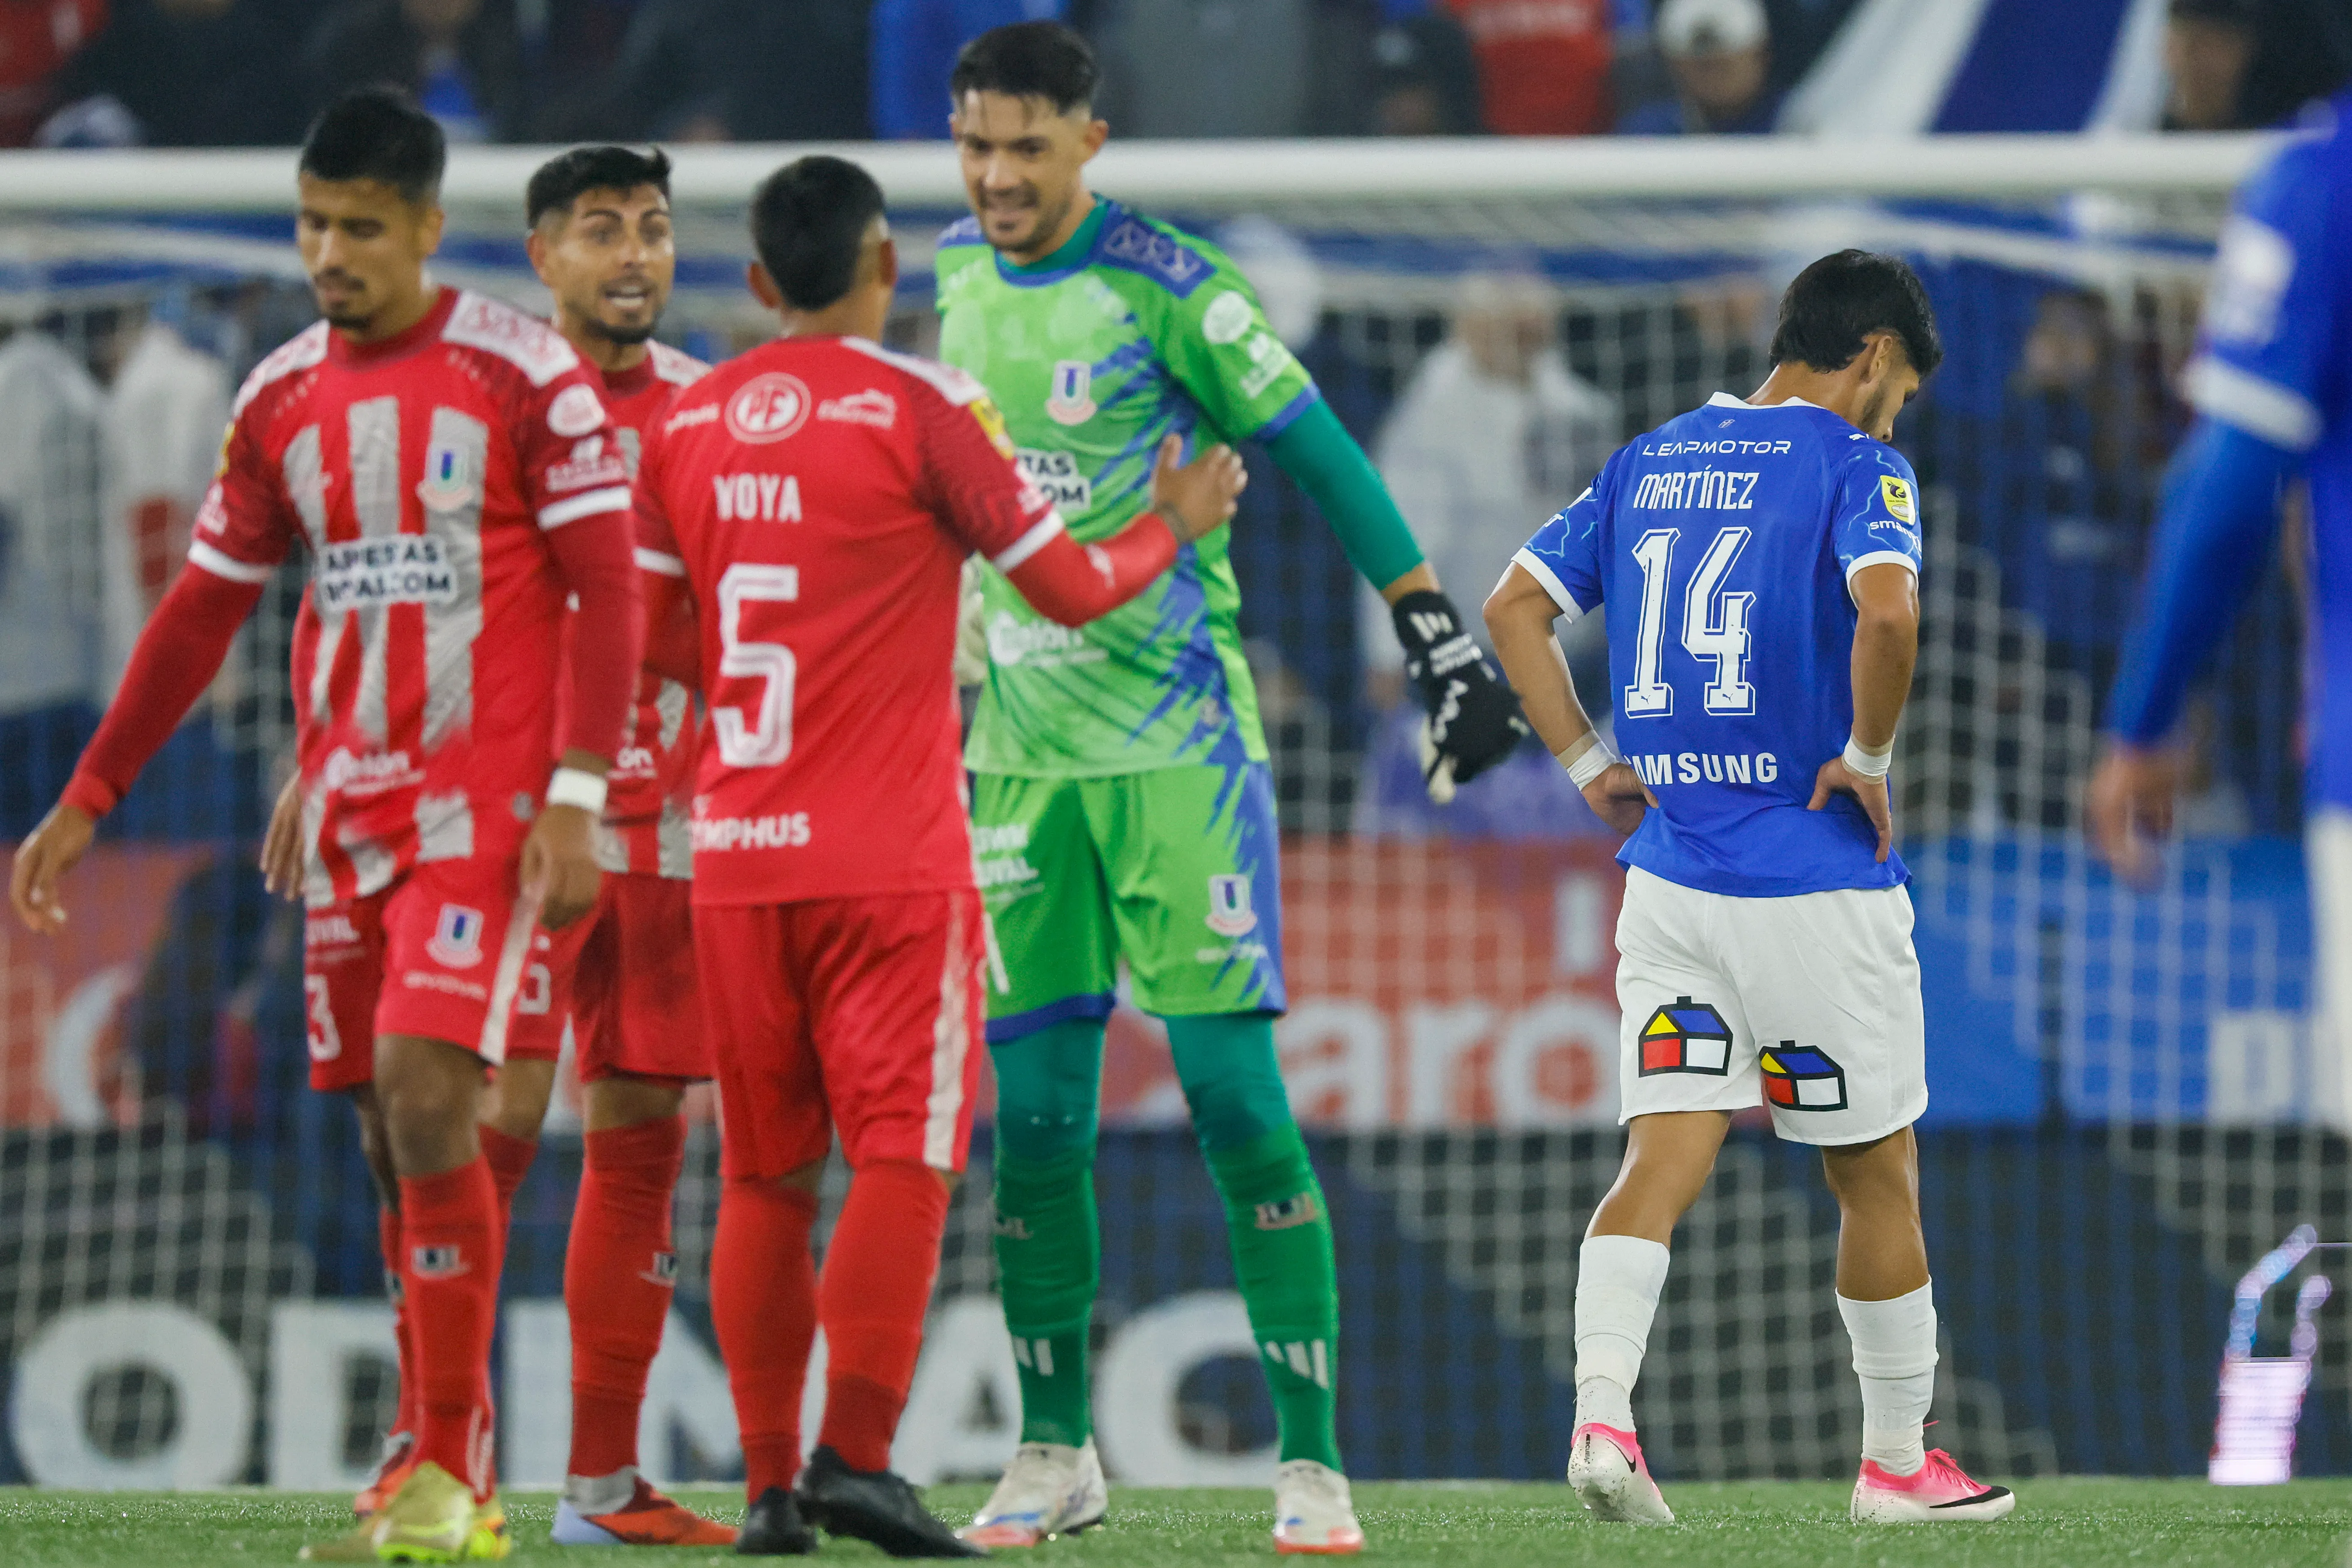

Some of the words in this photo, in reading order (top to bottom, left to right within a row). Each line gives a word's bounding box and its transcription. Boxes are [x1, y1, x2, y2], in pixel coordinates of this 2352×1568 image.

[1633, 465, 1759, 510] MARTÍNEZ
[1642, 440, 1792, 456] LEAPMOTOR
[713, 563, 798, 767] 5
[1625, 527, 1757, 719] 14
[1623, 752, 1778, 785] AMSUNG
[1274, 992, 1620, 1131] aro
